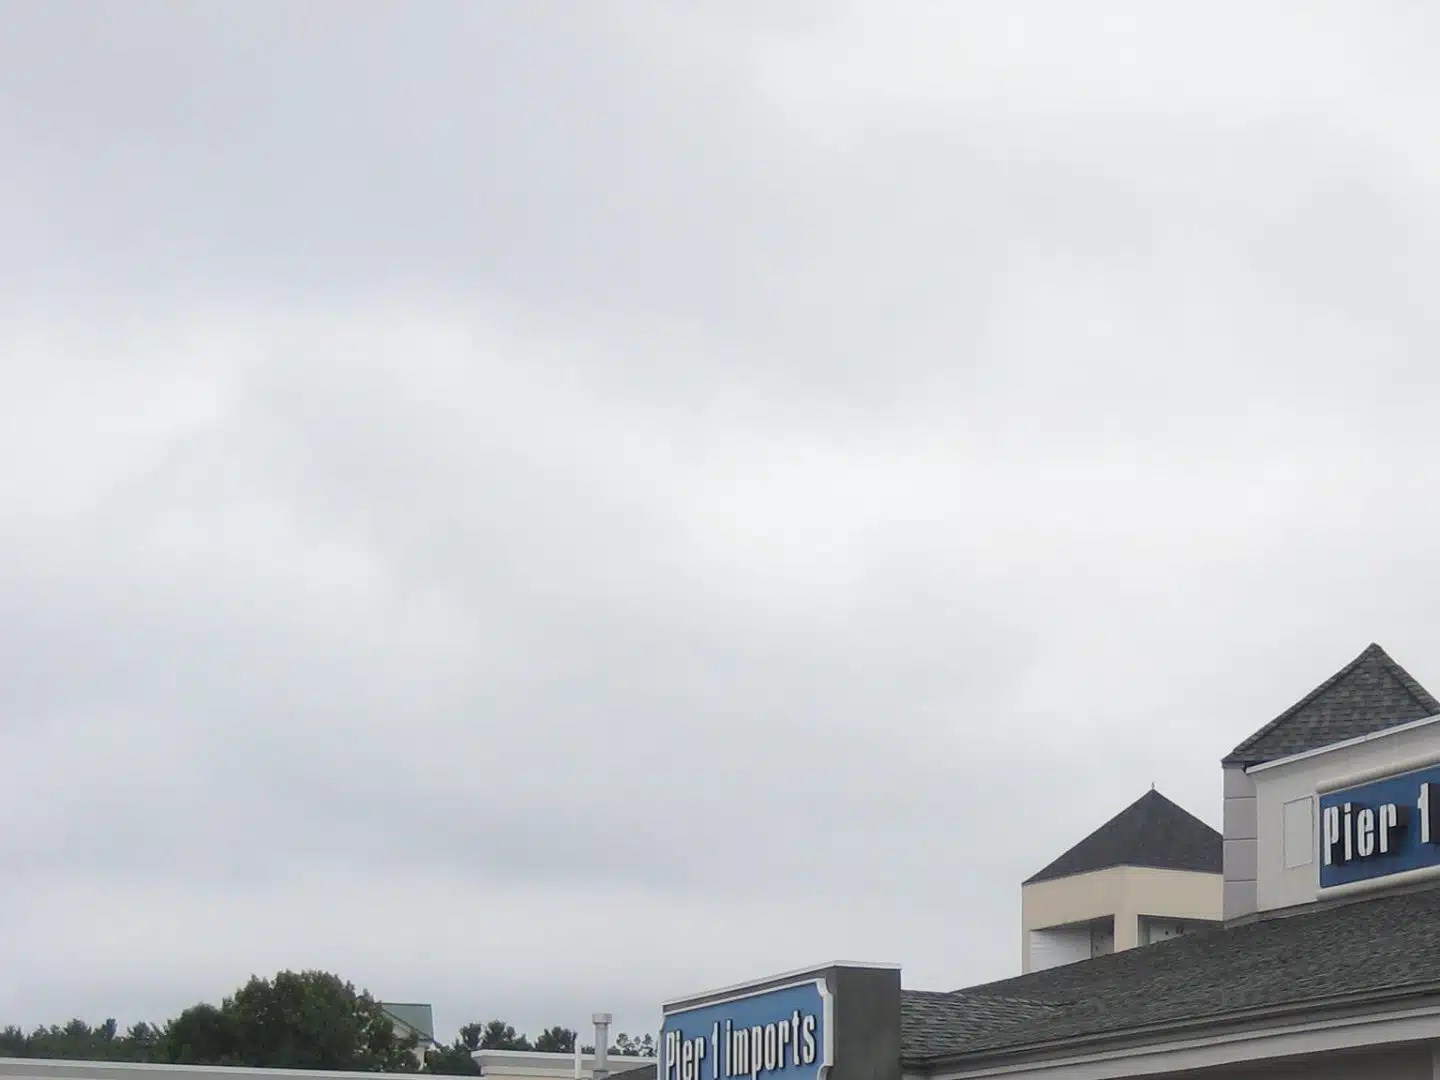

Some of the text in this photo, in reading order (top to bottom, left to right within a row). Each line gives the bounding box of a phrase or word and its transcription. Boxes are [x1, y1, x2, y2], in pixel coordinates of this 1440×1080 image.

[1323, 802, 1398, 866] Pier
[1417, 781, 1431, 844] 1
[712, 1021, 719, 1079] 1
